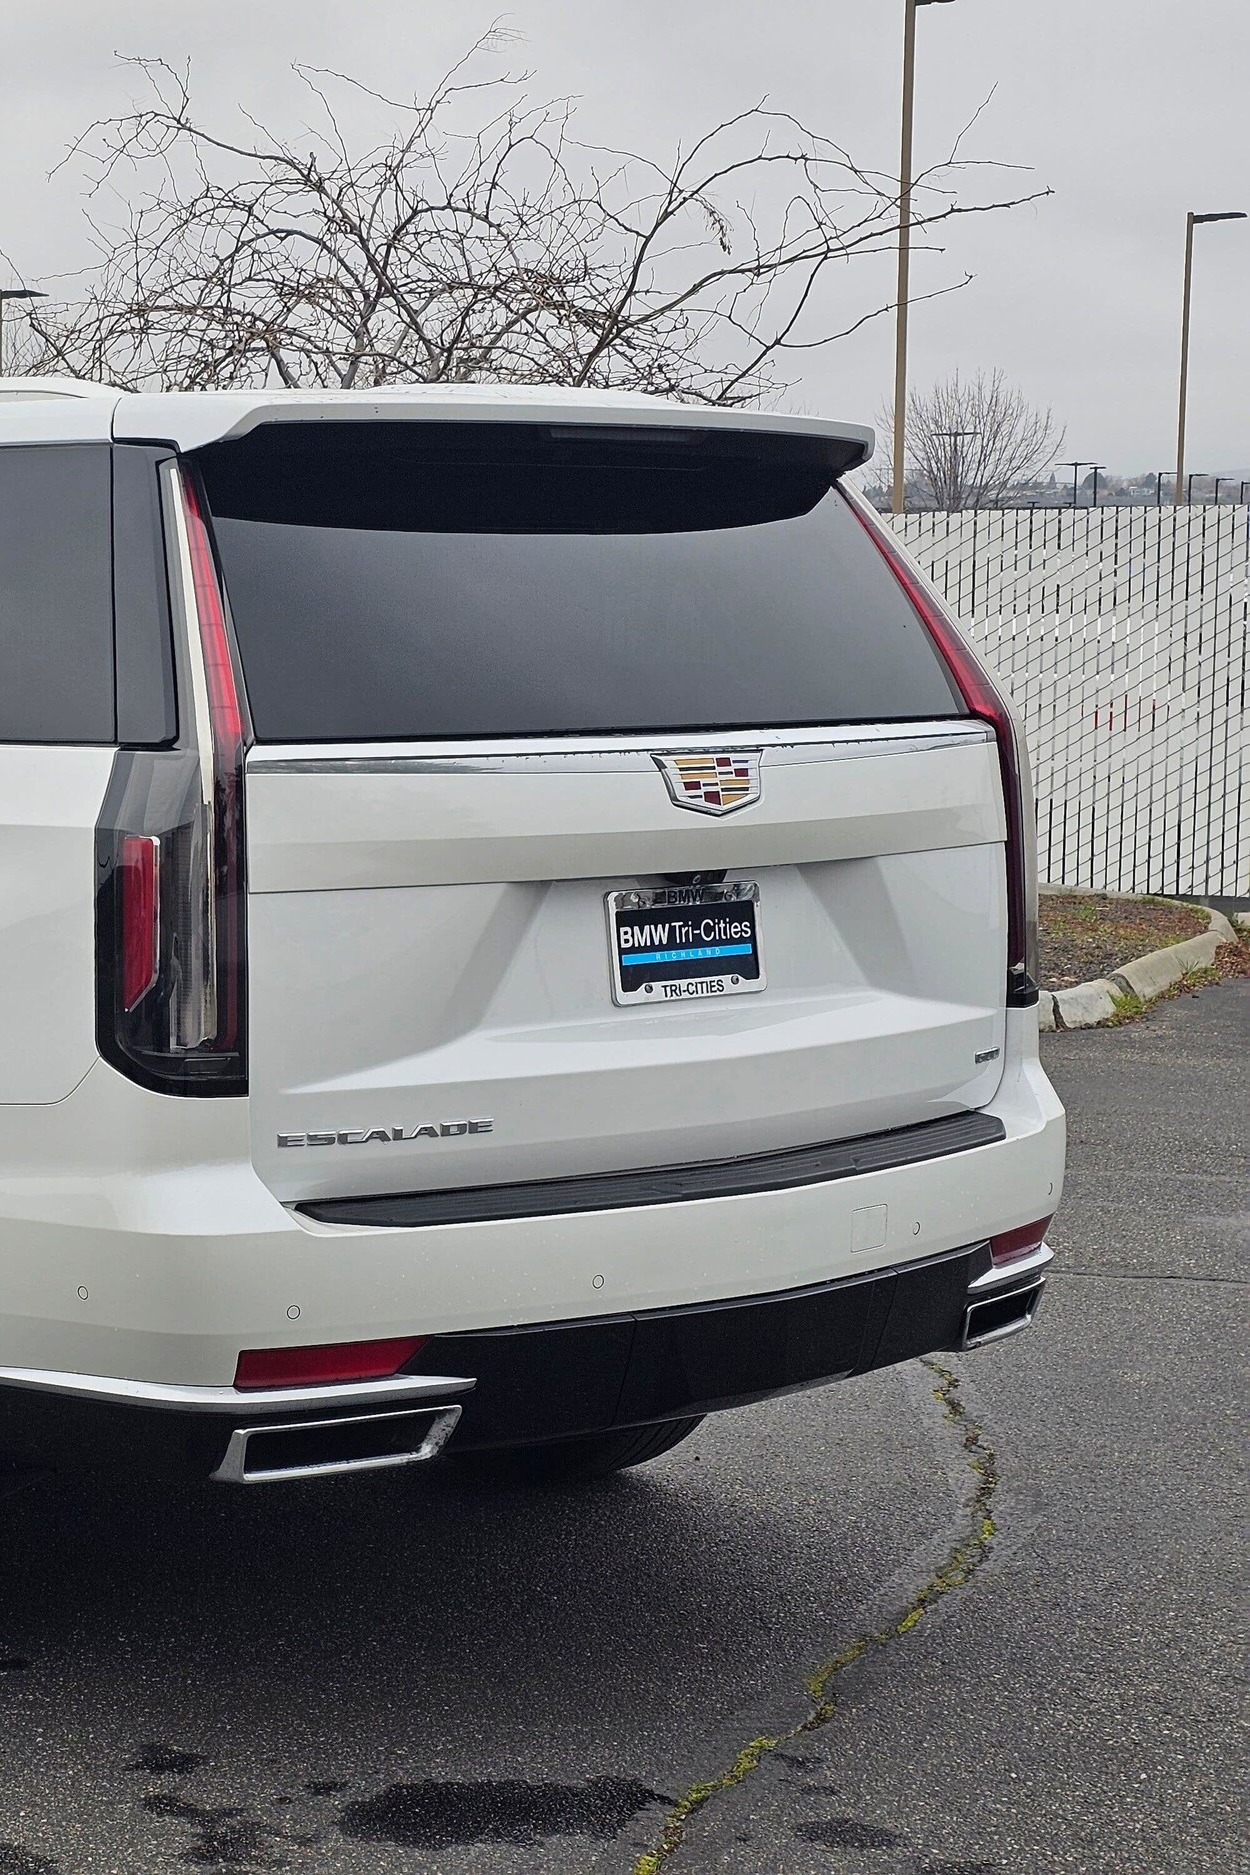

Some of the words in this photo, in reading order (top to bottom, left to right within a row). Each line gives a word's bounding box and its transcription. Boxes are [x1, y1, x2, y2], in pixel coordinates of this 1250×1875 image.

[667, 888, 705, 905] BMW
[619, 923, 669, 949] BMW
[671, 917, 752, 944] Tri-Cities
[654, 948, 721, 961] RICHLAND
[661, 979, 725, 998] TRI-CITIES
[277, 1116, 495, 1149] ESCALADE
